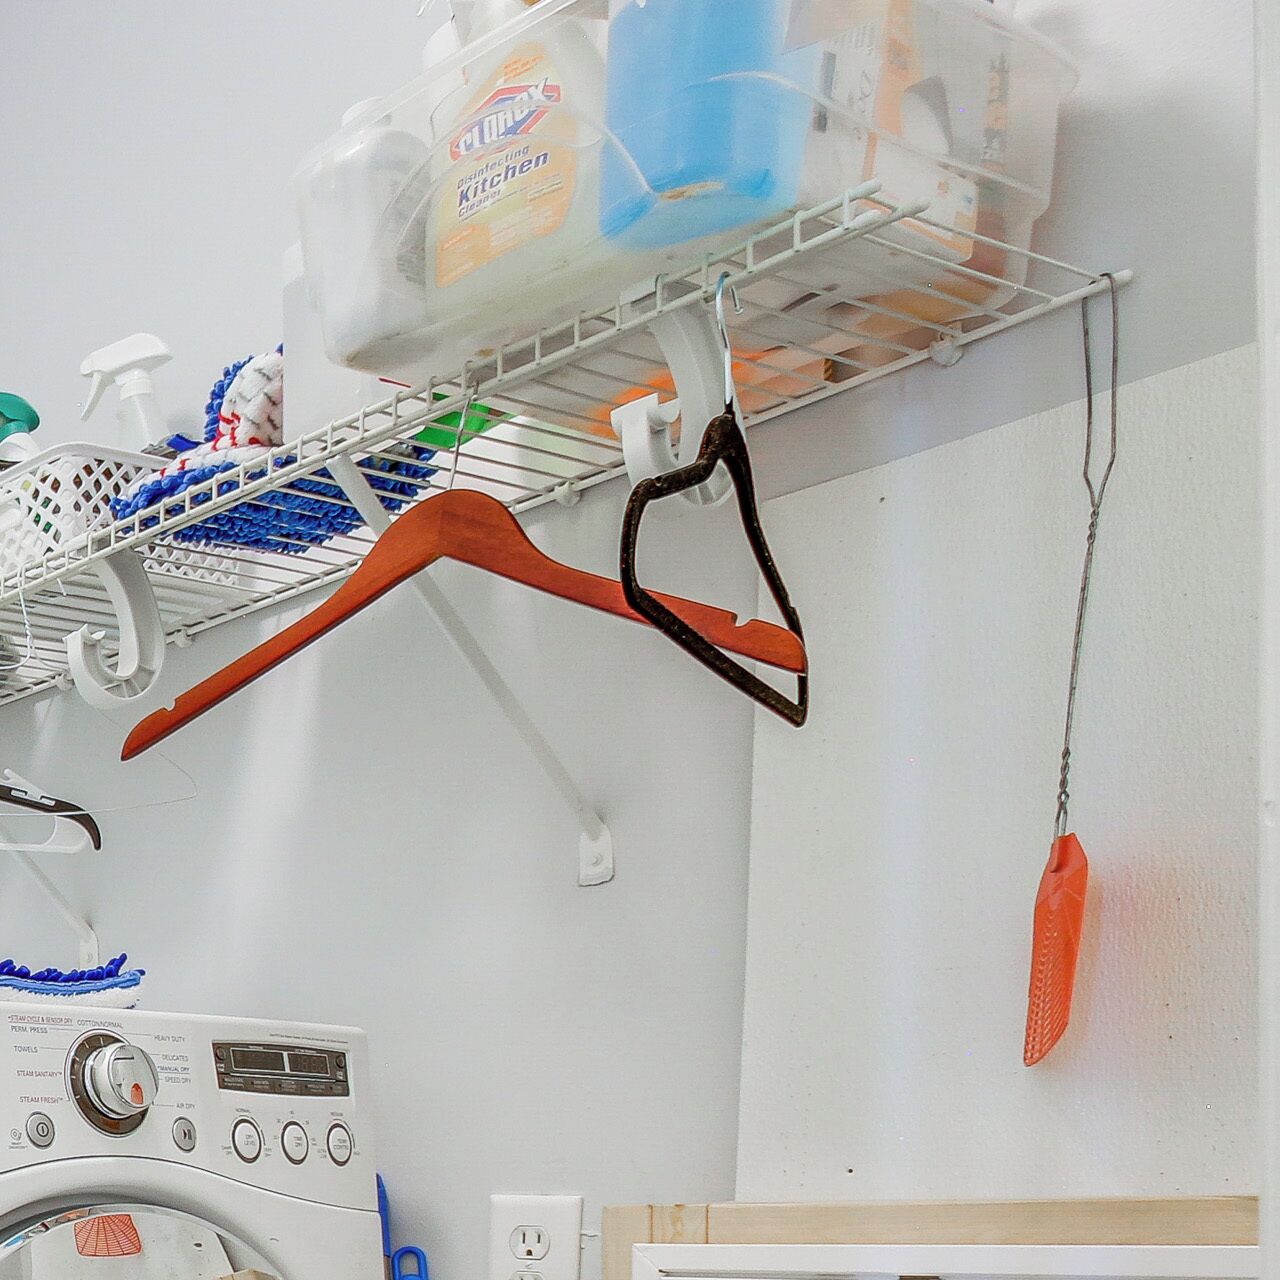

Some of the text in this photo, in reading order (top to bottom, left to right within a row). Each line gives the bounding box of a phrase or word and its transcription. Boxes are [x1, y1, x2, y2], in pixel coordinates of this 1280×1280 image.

[456, 77, 549, 153] CLOROX
[457, 144, 530, 190] Disinfecting
[458, 151, 550, 208] Kitchen
[13, 1045, 38, 1053] TOWELS
[29, 1026, 48, 1034] PRESS
